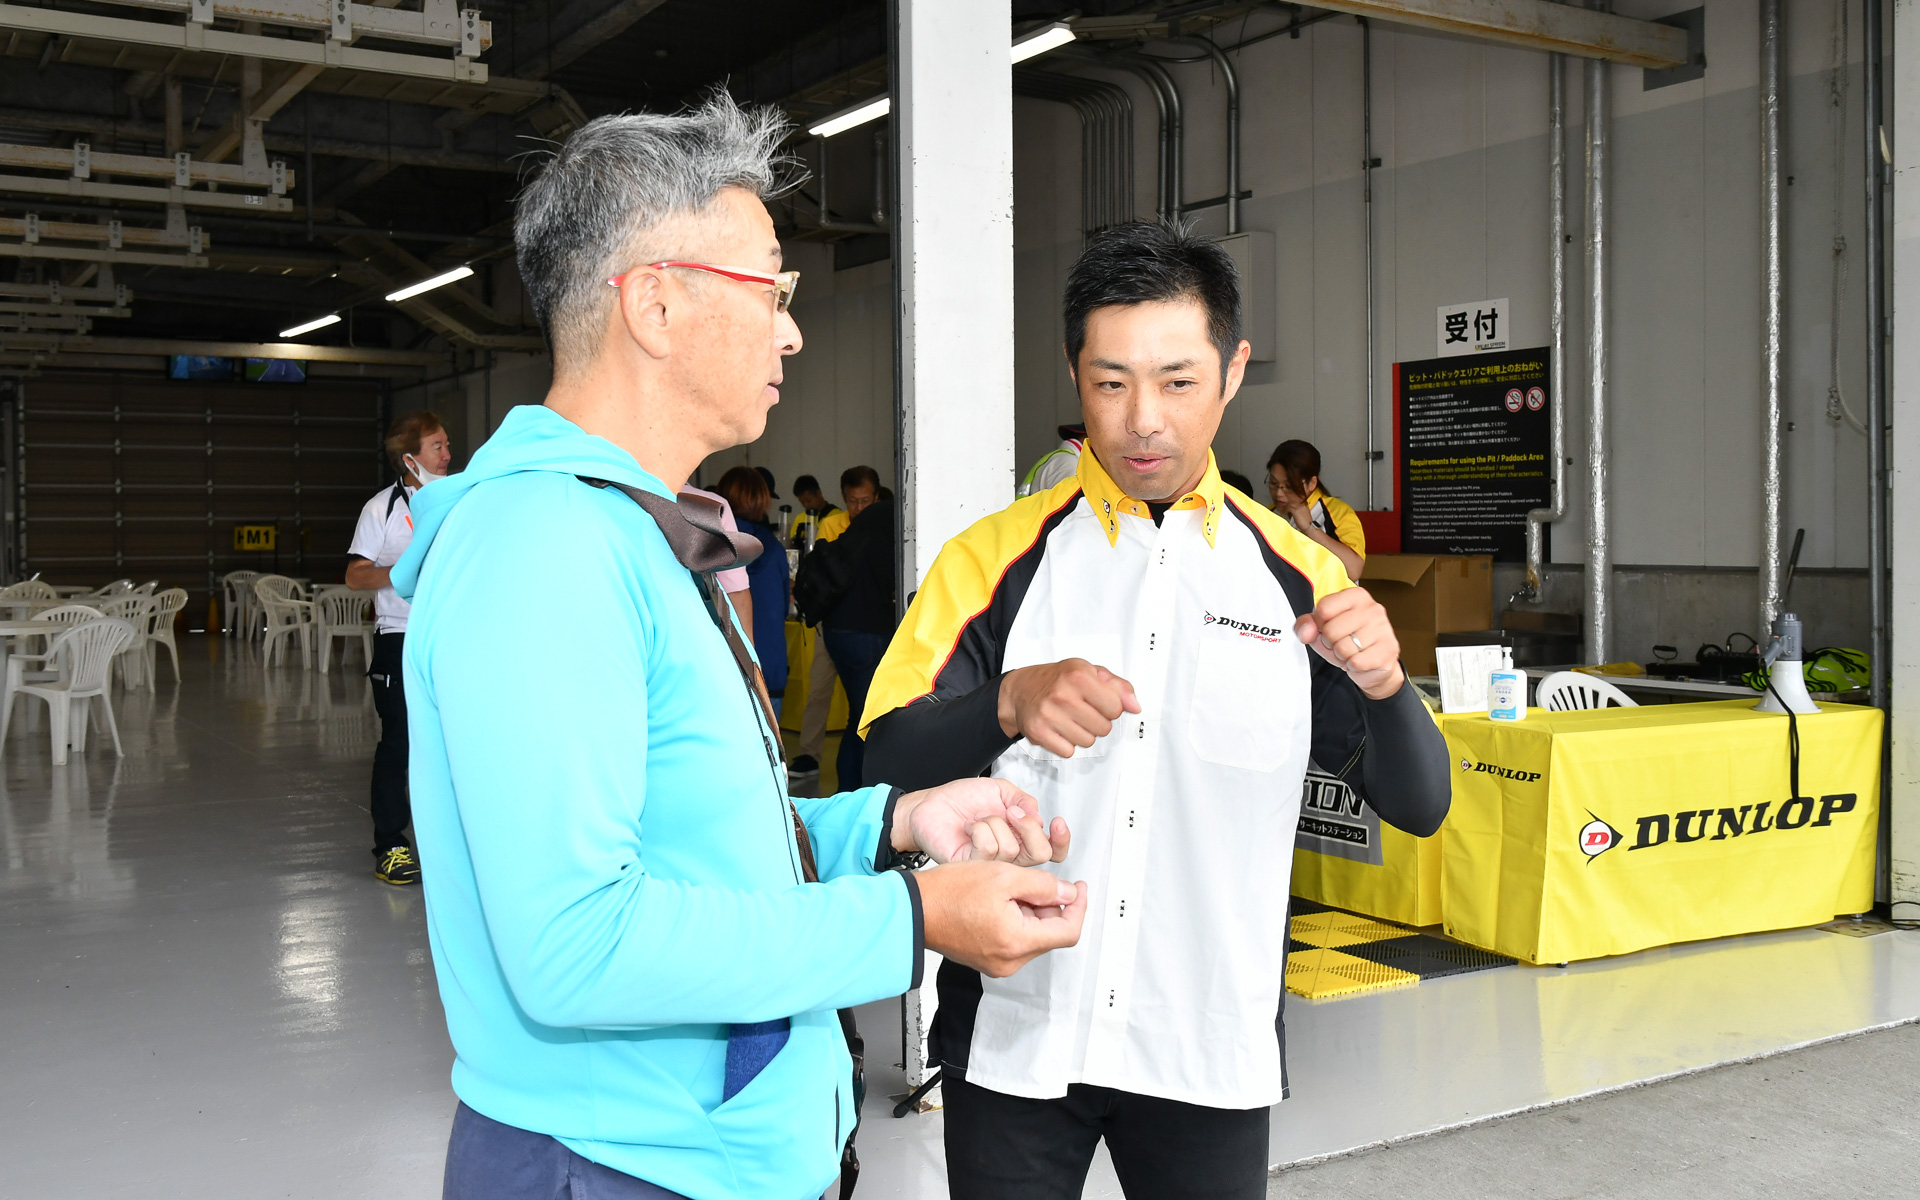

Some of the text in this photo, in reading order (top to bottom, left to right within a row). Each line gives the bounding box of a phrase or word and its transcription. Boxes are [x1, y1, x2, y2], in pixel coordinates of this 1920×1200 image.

[1445, 307, 1498, 344] 受付
[1410, 459, 1449, 467] Requirements
[1459, 456, 1476, 465] using
[247, 530, 269, 544] M1
[1217, 616, 1281, 636] DUNLOP
[1239, 632, 1281, 643] MOTORSPORT
[1474, 762, 1541, 782] DUNLOP
[1627, 793, 1857, 851] DUNLOP
